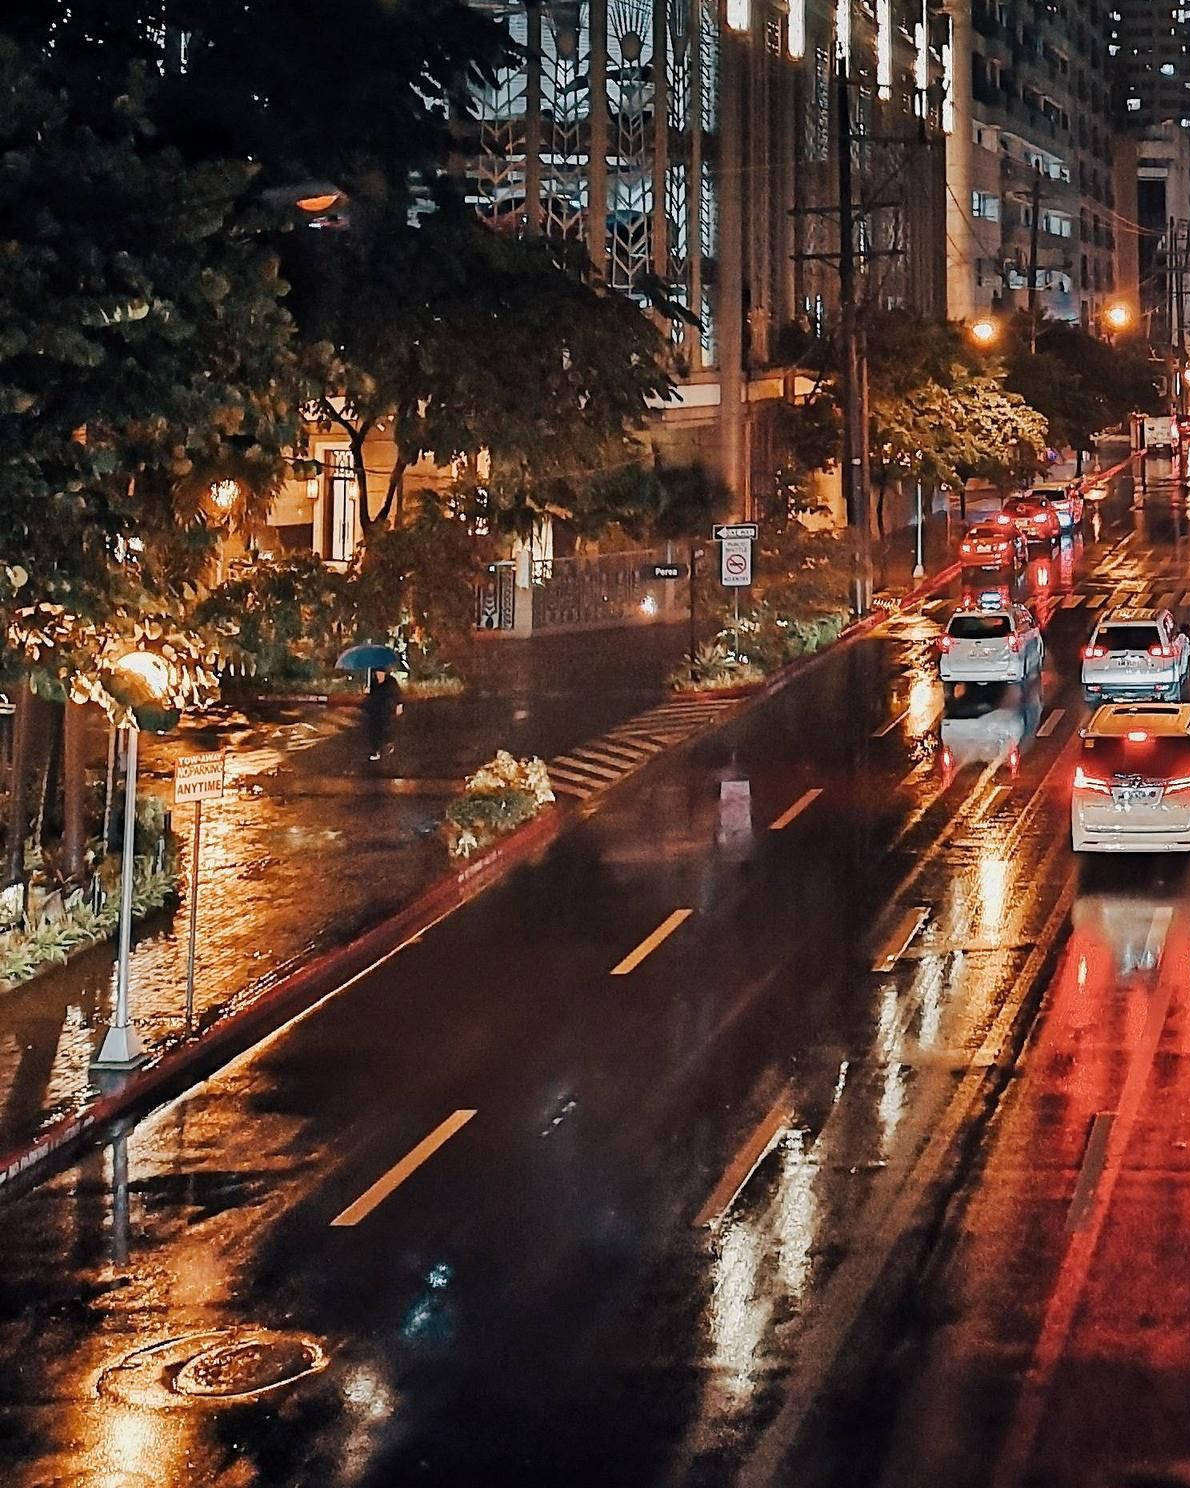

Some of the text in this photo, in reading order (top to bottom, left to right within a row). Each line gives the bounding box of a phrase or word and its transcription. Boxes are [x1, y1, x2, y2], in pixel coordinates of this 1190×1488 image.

[655, 567, 678, 576] Perea
[177, 762, 223, 778] NO PARKING
[177, 780, 221, 794] ANYTIME
